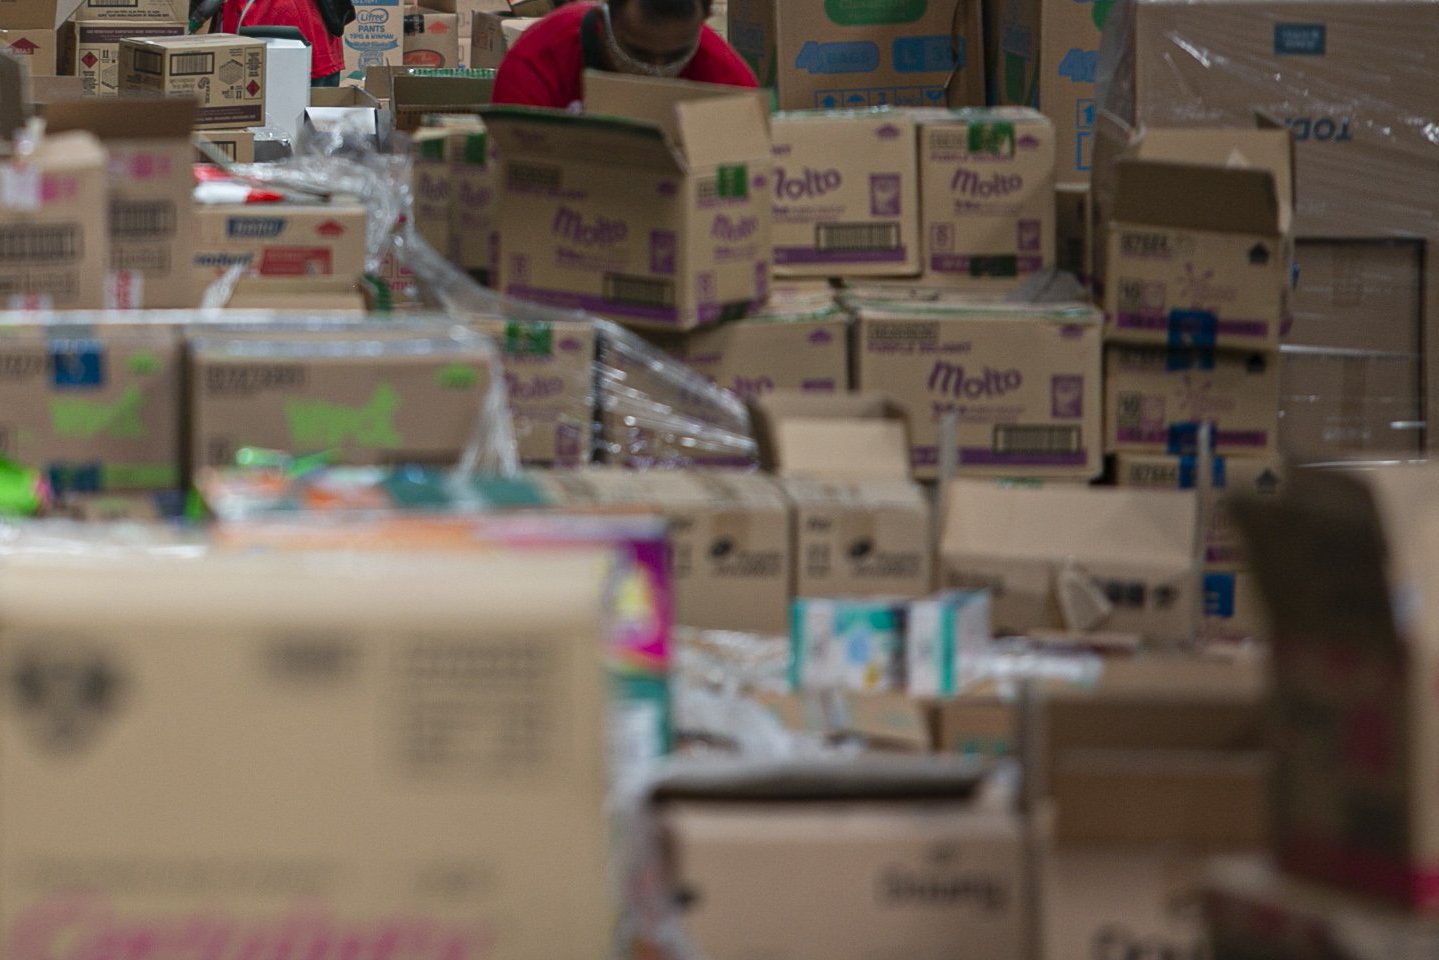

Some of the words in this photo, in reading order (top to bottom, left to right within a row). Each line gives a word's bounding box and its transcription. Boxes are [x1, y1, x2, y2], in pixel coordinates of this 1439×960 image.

[358, 25, 385, 33] PANTS
[360, 11, 384, 21] Lifree
[950, 167, 1023, 198] Molto
[552, 206, 629, 246] Molto
[927, 361, 1024, 400] Molto
